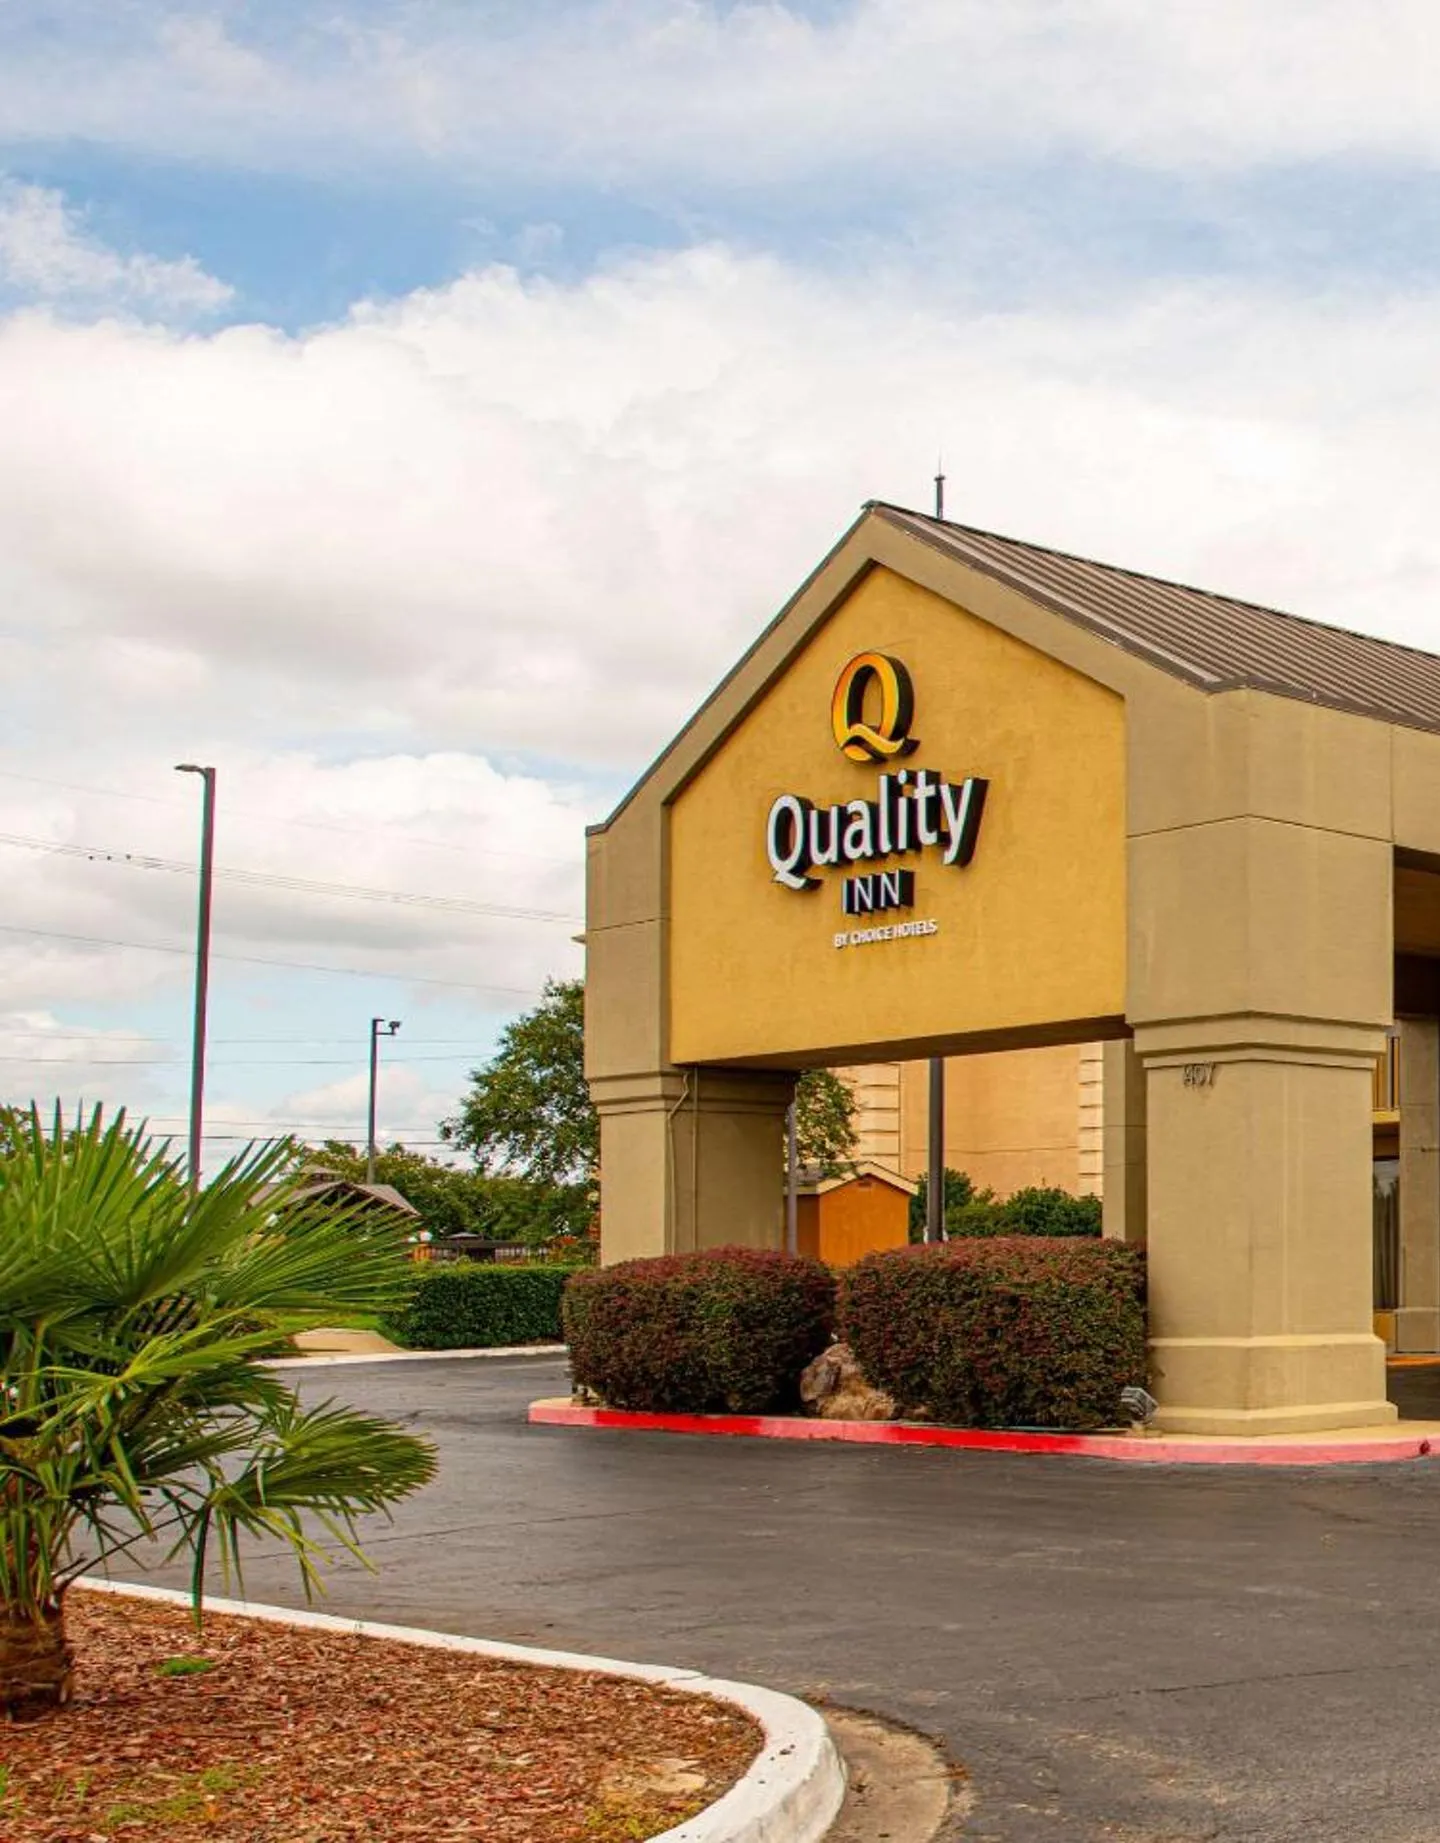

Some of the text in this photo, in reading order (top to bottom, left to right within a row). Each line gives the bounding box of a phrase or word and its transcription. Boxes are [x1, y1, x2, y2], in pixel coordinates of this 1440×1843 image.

[832, 652, 917, 762] Q
[767, 769, 986, 889] Quality
[842, 870, 914, 914] INN
[834, 920, 938, 949] BY CHOICE HOTELS
